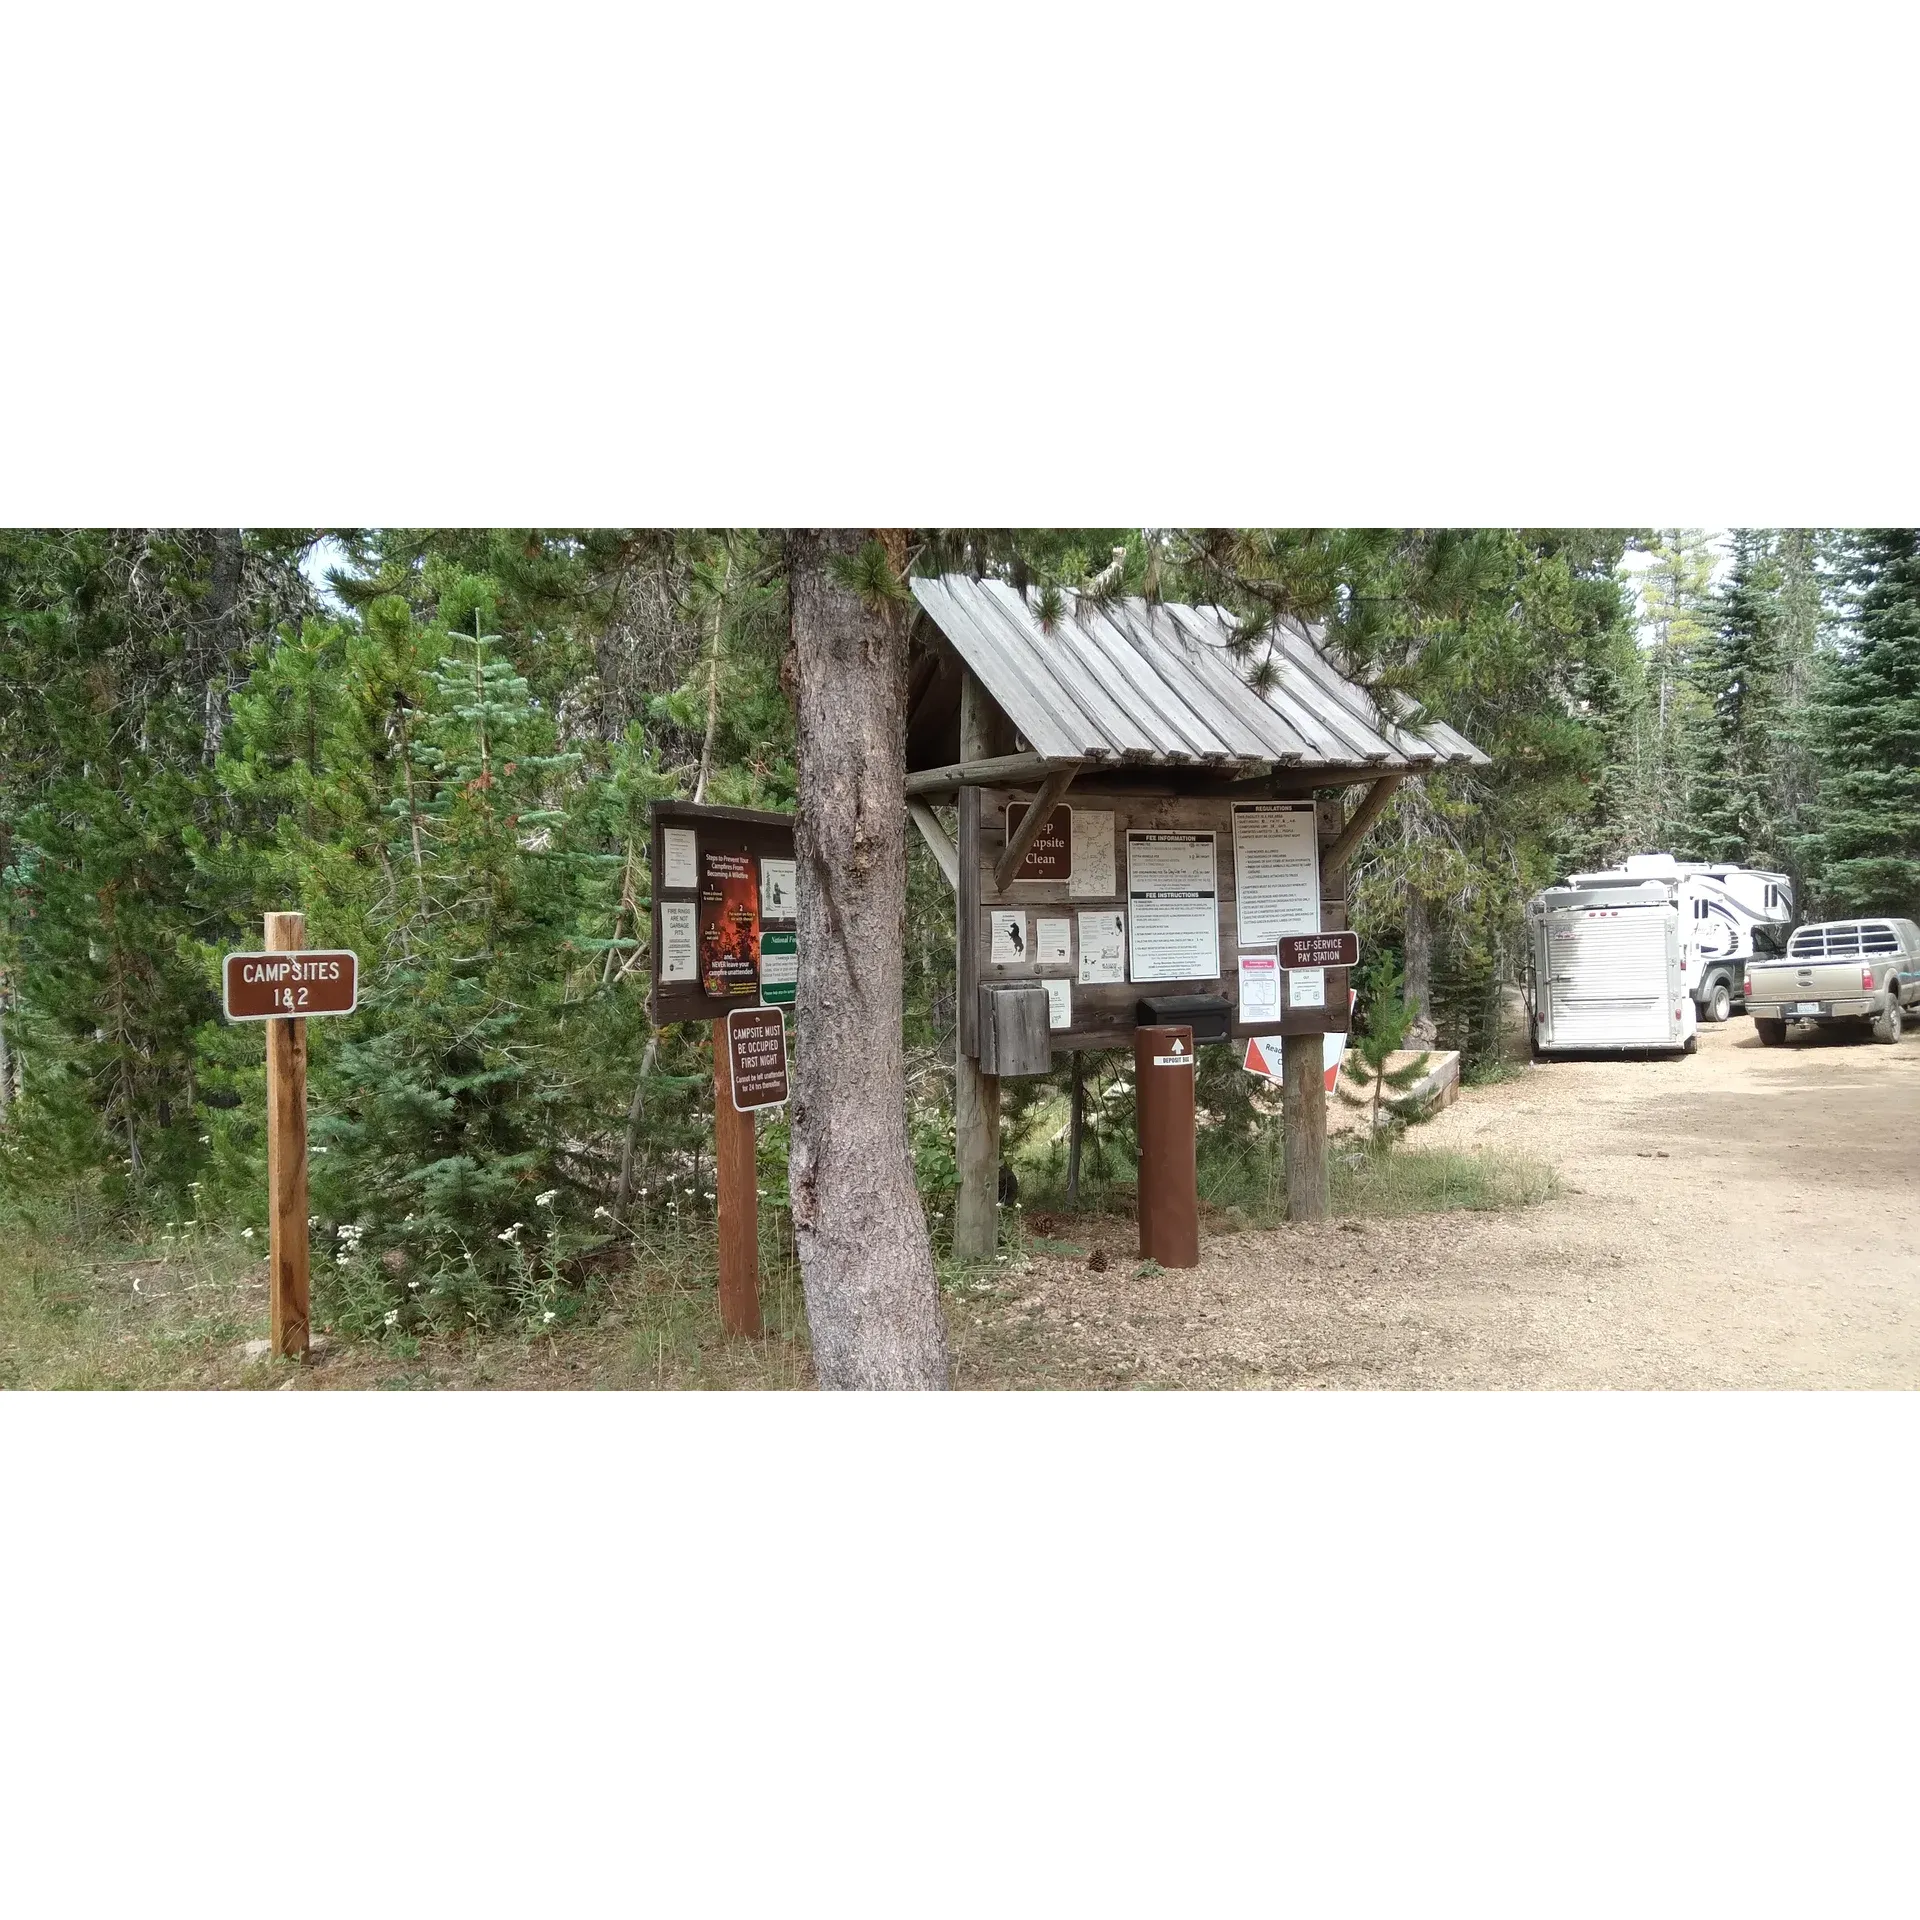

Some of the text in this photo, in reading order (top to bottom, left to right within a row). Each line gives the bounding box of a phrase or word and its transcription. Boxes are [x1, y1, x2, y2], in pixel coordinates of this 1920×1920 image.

[1026, 853, 1055, 863] Clean
[707, 870, 728, 879] Becoming
[771, 935, 788, 943] National
[1294, 939, 1342, 951] SELF-SERVICE
[1298, 951, 1339, 962] PAY STATION
[243, 962, 340, 983] CAMPSITES
[733, 1025, 780, 1040] CAMPSITE MUST
[738, 1040, 778, 1054] BE OCCUPIED
[741, 1054, 777, 1068] FIRST NIGHT
[764, 1070, 784, 1079] unattended
[762, 1080, 780, 1088] thereafter
